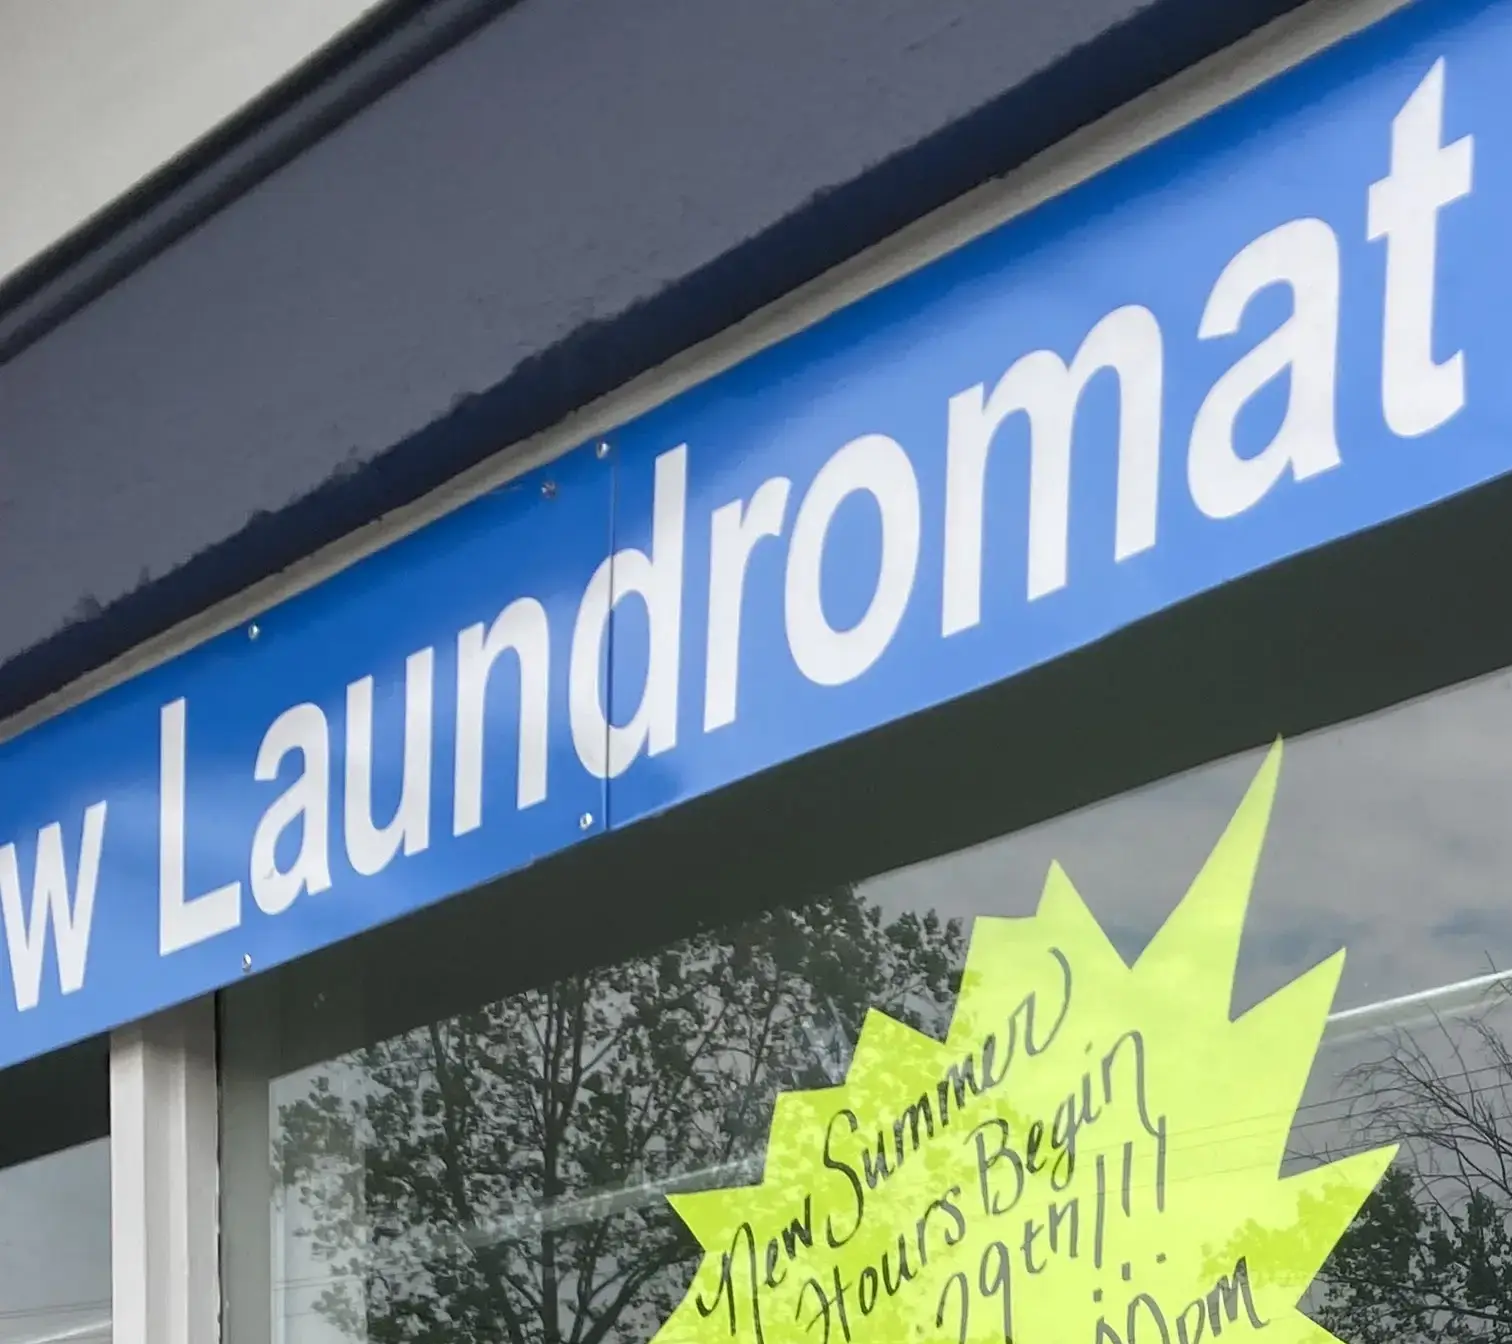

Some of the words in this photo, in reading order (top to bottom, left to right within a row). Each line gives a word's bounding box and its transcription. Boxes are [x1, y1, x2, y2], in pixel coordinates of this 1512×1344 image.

[0, 799, 107, 1012] w
[159, 55, 1474, 956] Laundromat
[823, 945, 1072, 1251] Summer
[976, 1028, 1165, 1208] Begin
